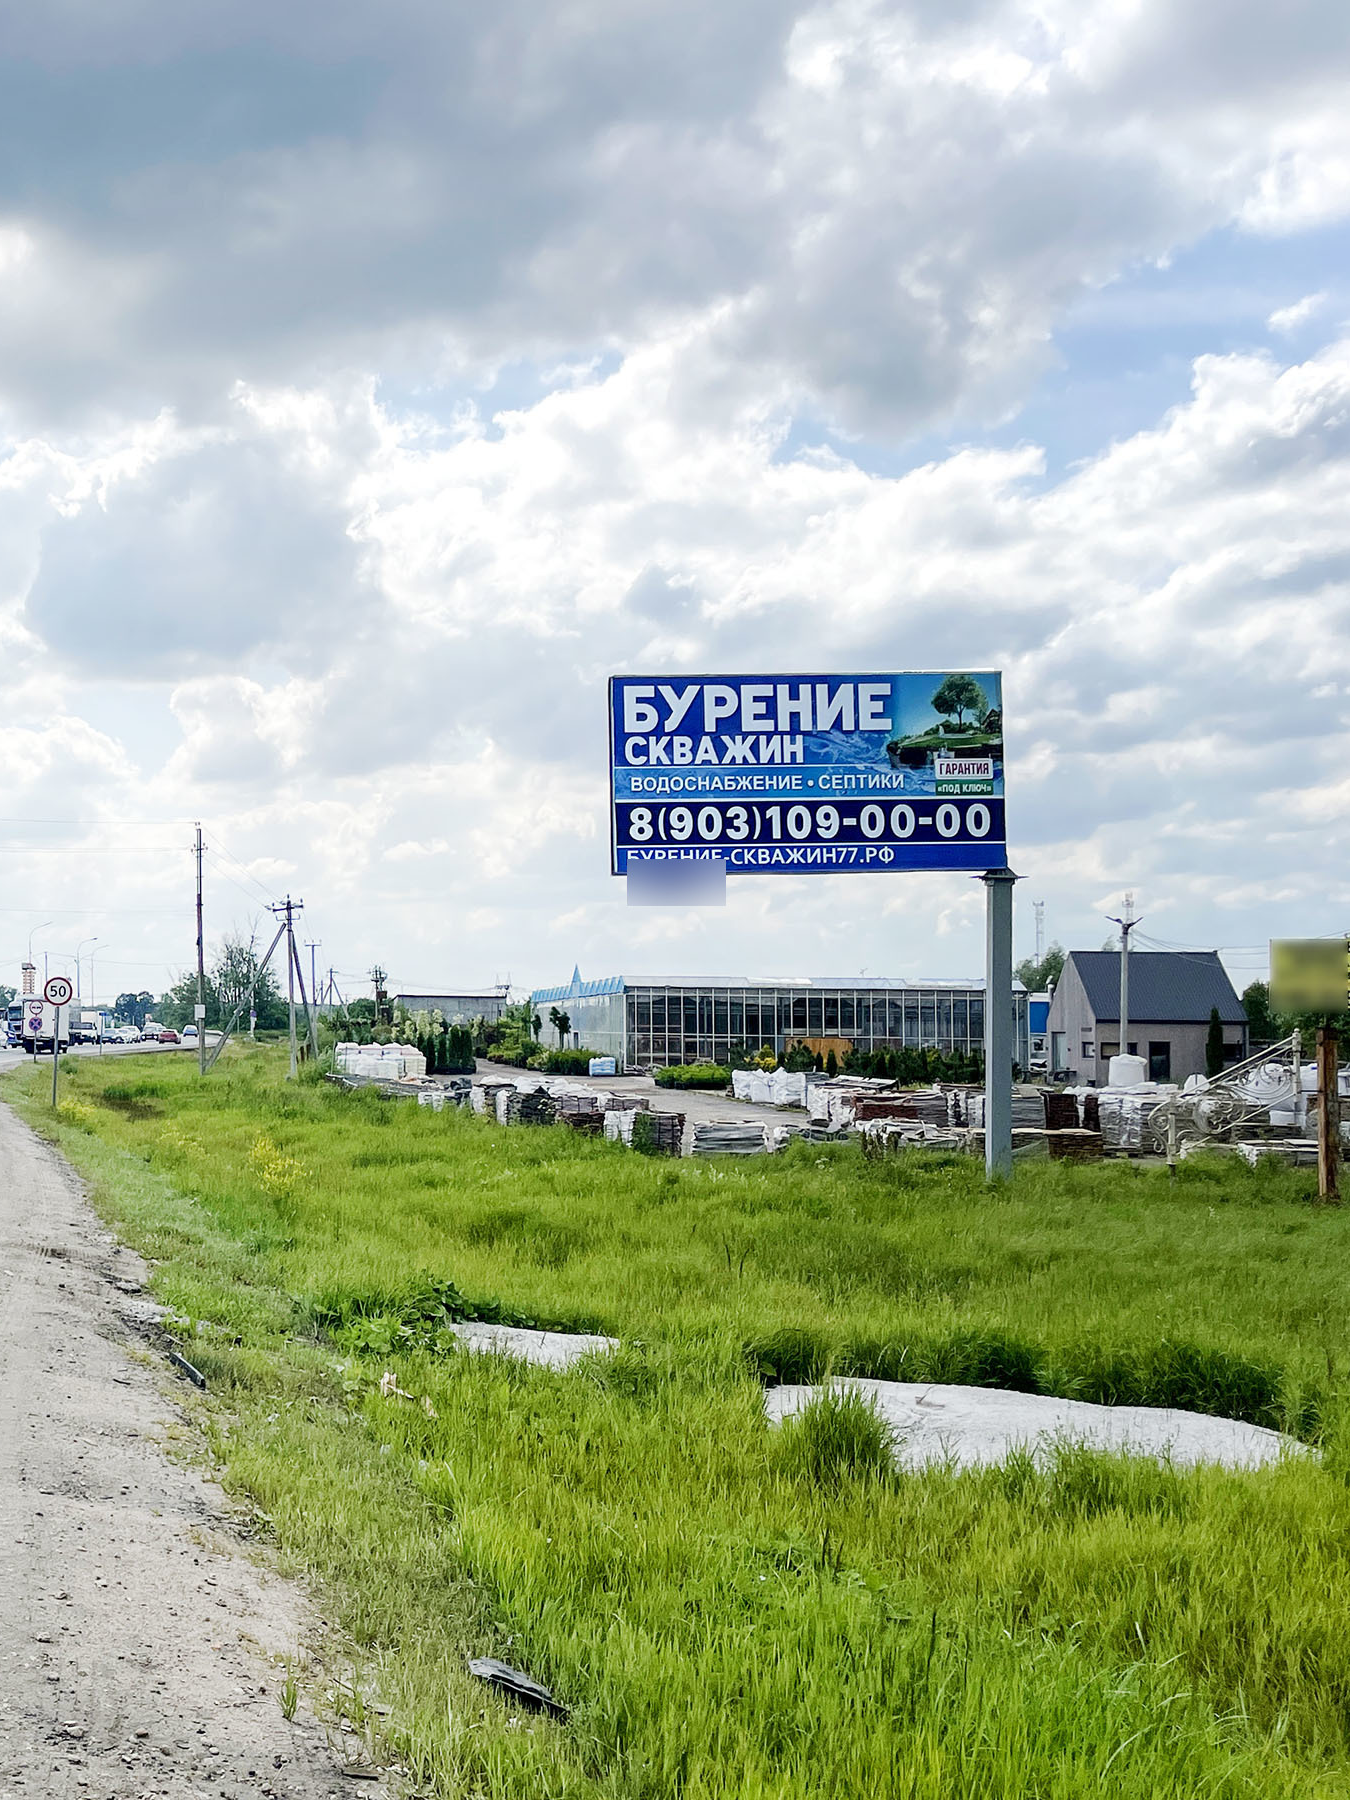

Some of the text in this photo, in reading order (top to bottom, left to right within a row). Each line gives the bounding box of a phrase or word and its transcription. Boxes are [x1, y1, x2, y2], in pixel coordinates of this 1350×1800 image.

[623, 683, 892, 733] БУРЕНИЕ
[624, 735, 804, 765] СКВАЖИН
[939, 763, 990, 775] ГАРАНТИЯ
[630, 774, 904, 793] ВОДОСНАБЖЕНИЕ СЕПТИКИ
[629, 803, 991, 841] 8(903)109-00-00
[50, 985, 67, 998] 50
